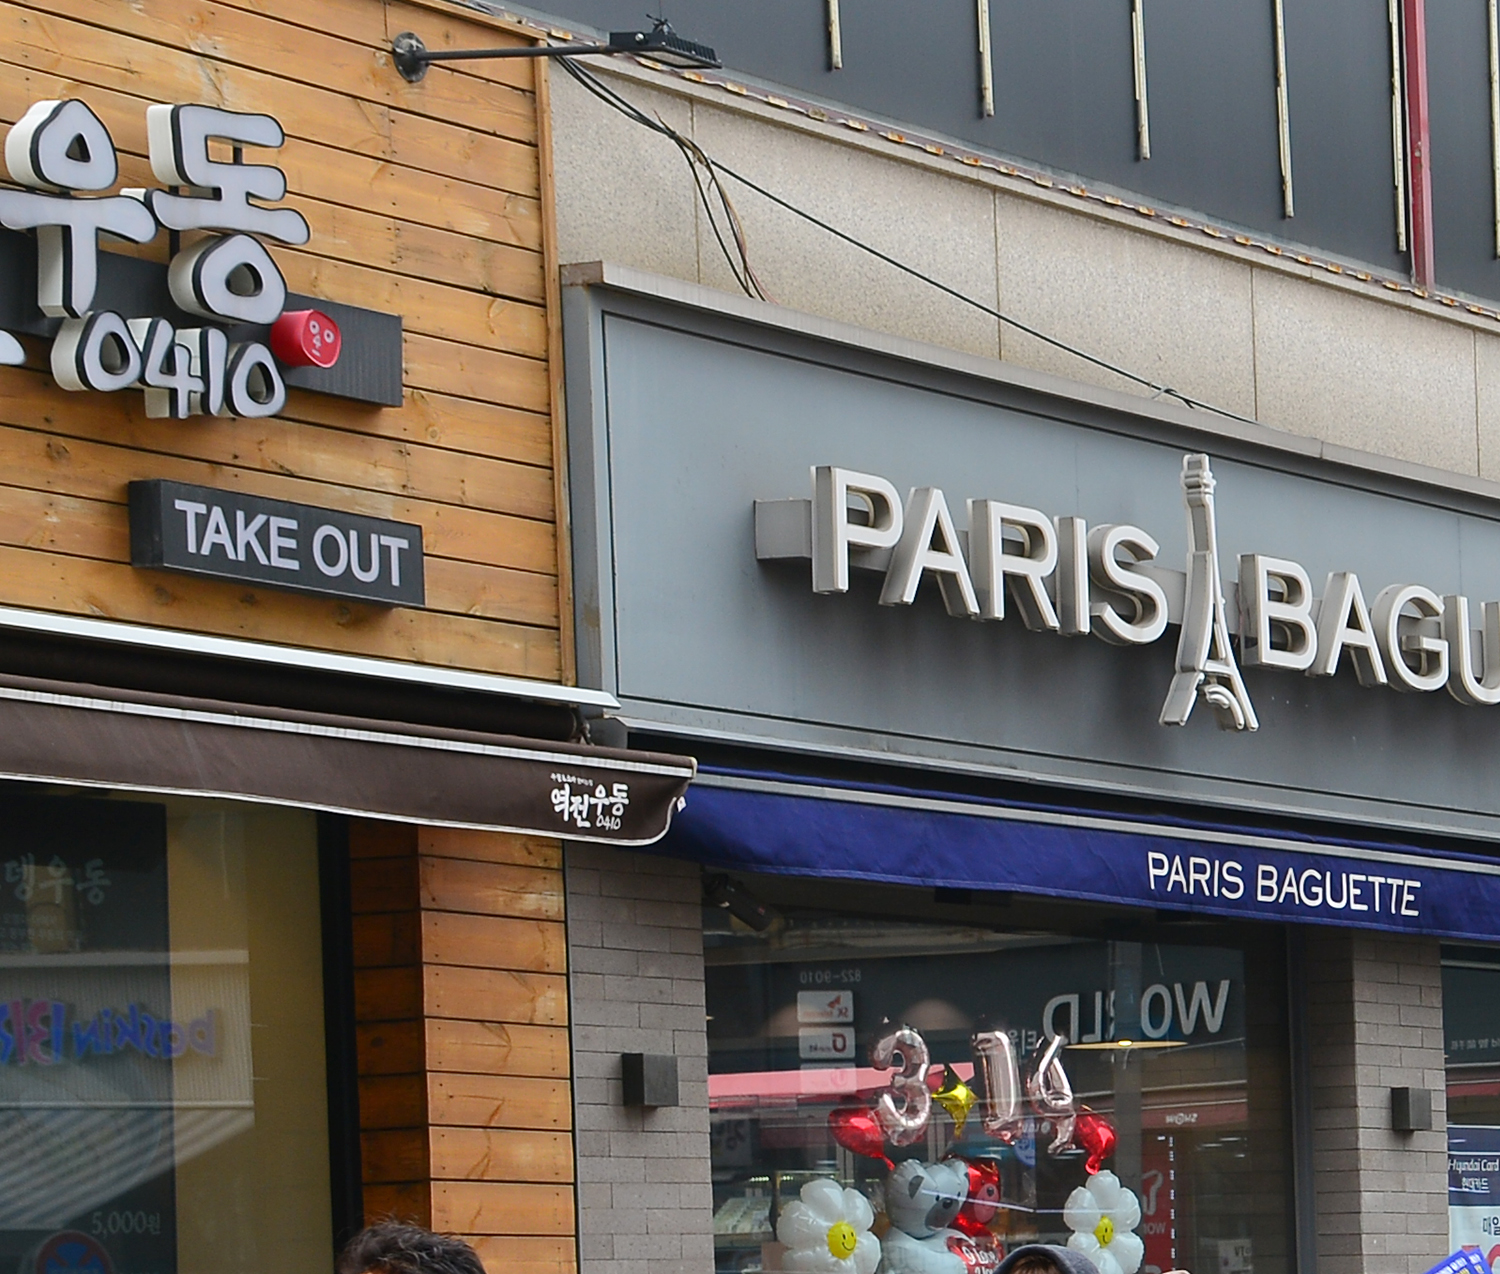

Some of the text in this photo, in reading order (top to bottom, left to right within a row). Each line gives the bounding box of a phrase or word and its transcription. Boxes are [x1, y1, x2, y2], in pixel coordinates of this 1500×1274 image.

[51, 310, 287, 420] 0410
[174, 499, 410, 588] TAKE OUT
[810, 465, 1169, 645] PARIS
[551, 783, 629, 828] 역전우동
[596, 815, 621, 830] 0410
[1147, 850, 1421, 917] PARIS BAGUETTE
[1461, 1177, 1489, 1191] 현대카드
[1480, 1158, 1499, 1172] Card
